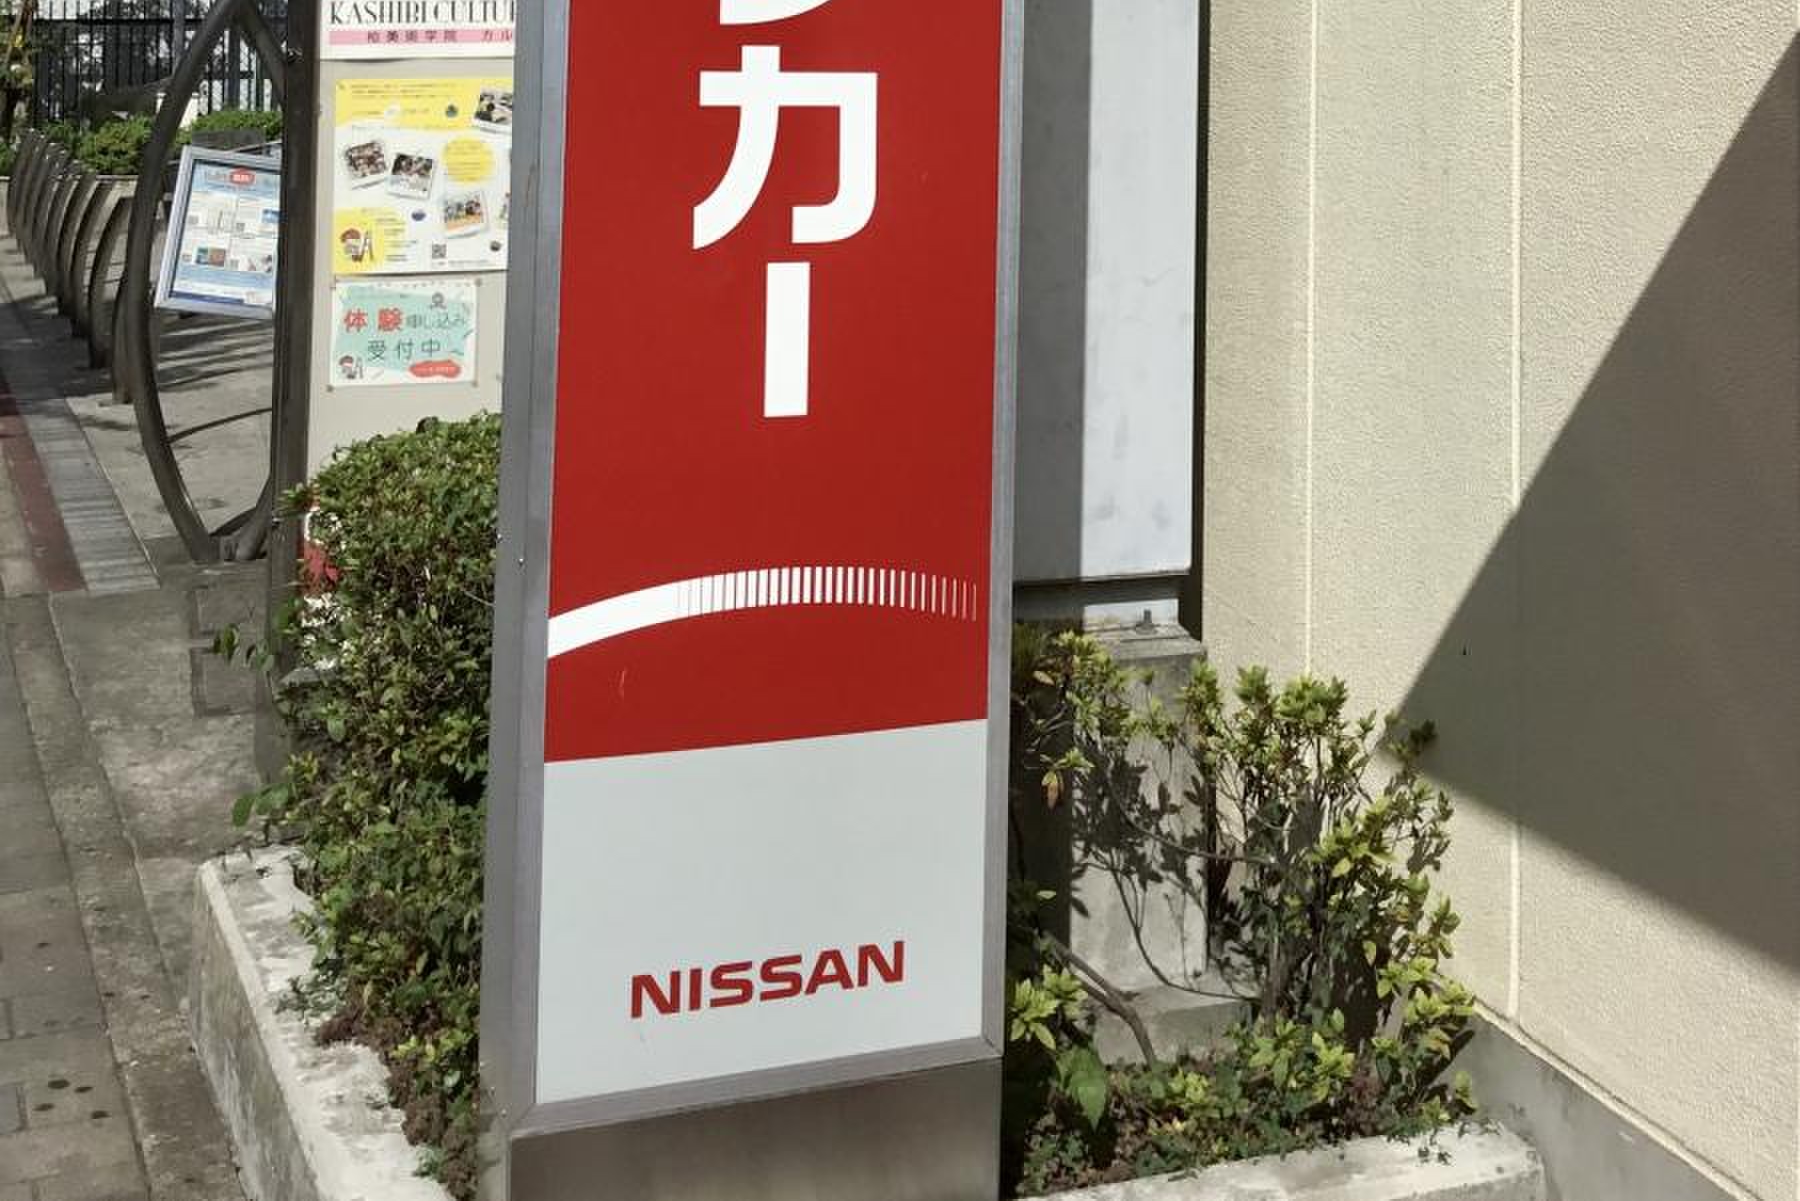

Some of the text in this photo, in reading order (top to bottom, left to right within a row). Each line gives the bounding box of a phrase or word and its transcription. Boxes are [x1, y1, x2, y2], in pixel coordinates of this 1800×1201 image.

[329, 0, 427, 24] KASHIBI
[367, 338, 442, 362] 受付中
[630, 940, 905, 1018] NISSAN
